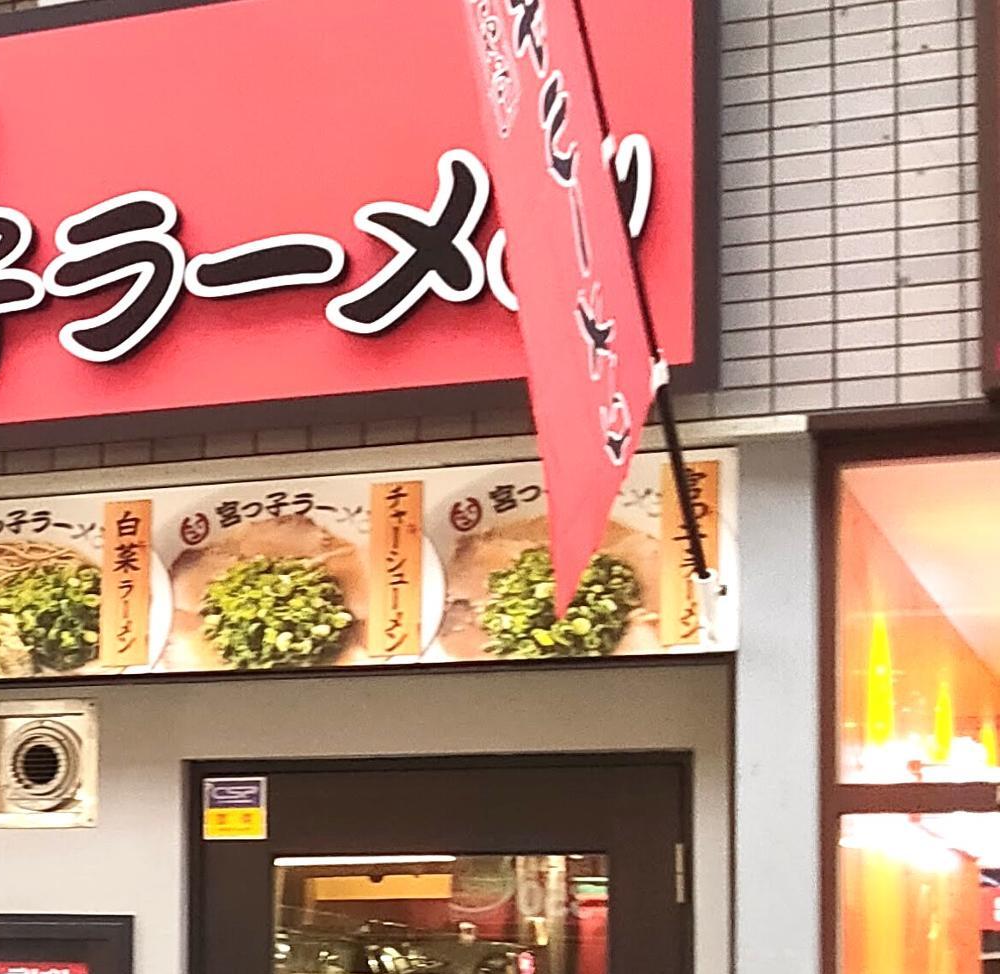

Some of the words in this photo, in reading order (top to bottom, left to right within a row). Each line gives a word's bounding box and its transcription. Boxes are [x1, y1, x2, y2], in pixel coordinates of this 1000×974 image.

[112, 510, 142, 654] 白菜ラーメン
